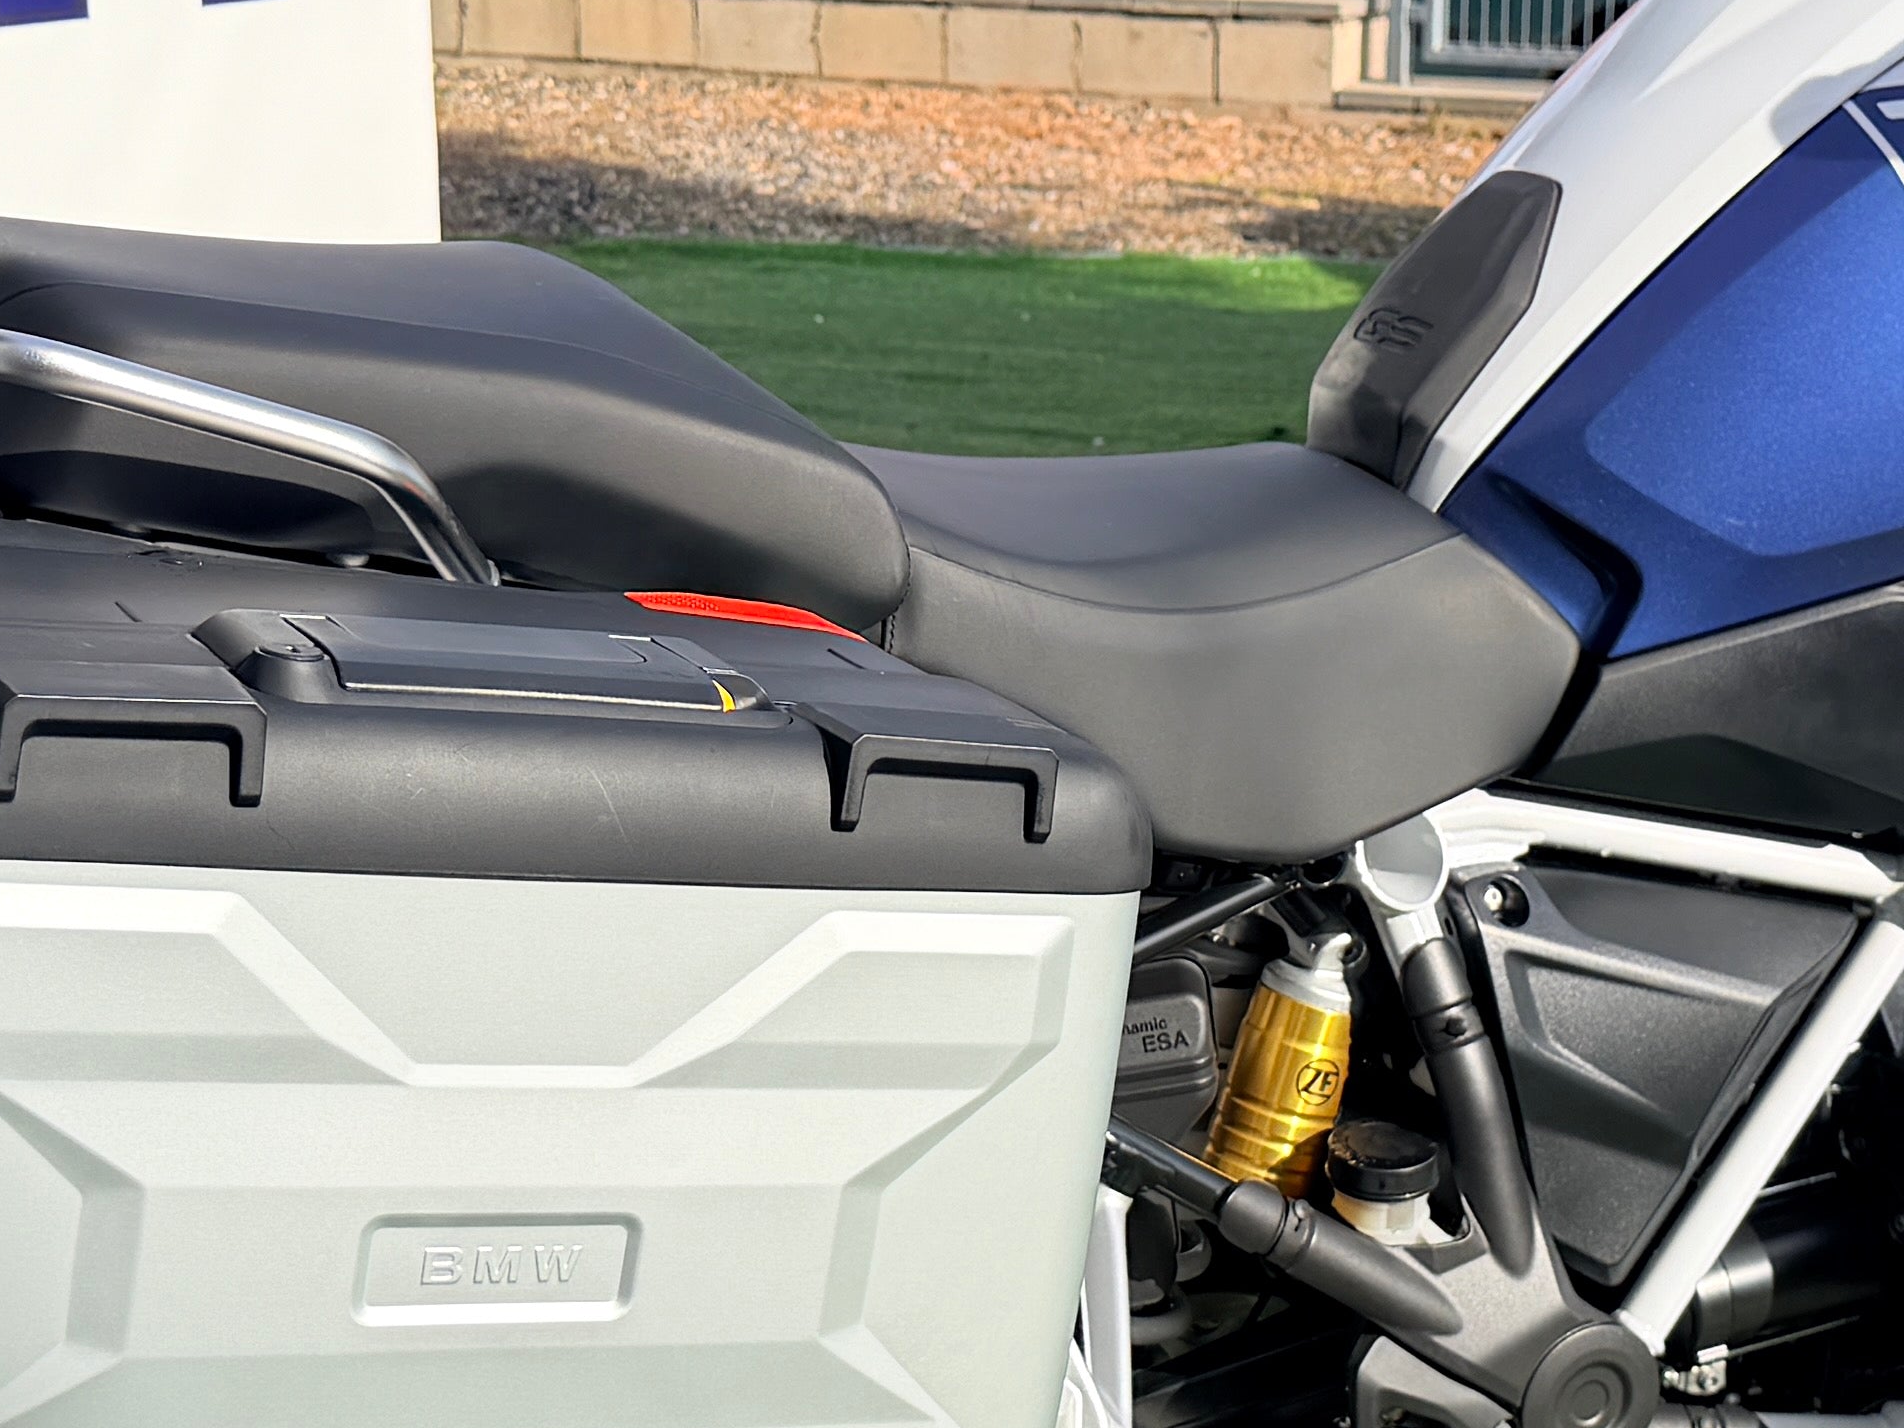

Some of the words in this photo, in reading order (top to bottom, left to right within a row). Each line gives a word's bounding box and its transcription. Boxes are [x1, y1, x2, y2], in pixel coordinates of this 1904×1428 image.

[1123, 1016, 1168, 1035] namic
[1142, 1030, 1190, 1053] ESA
[1300, 1069, 1339, 1097] ZF
[419, 1244, 584, 1287] BMW
